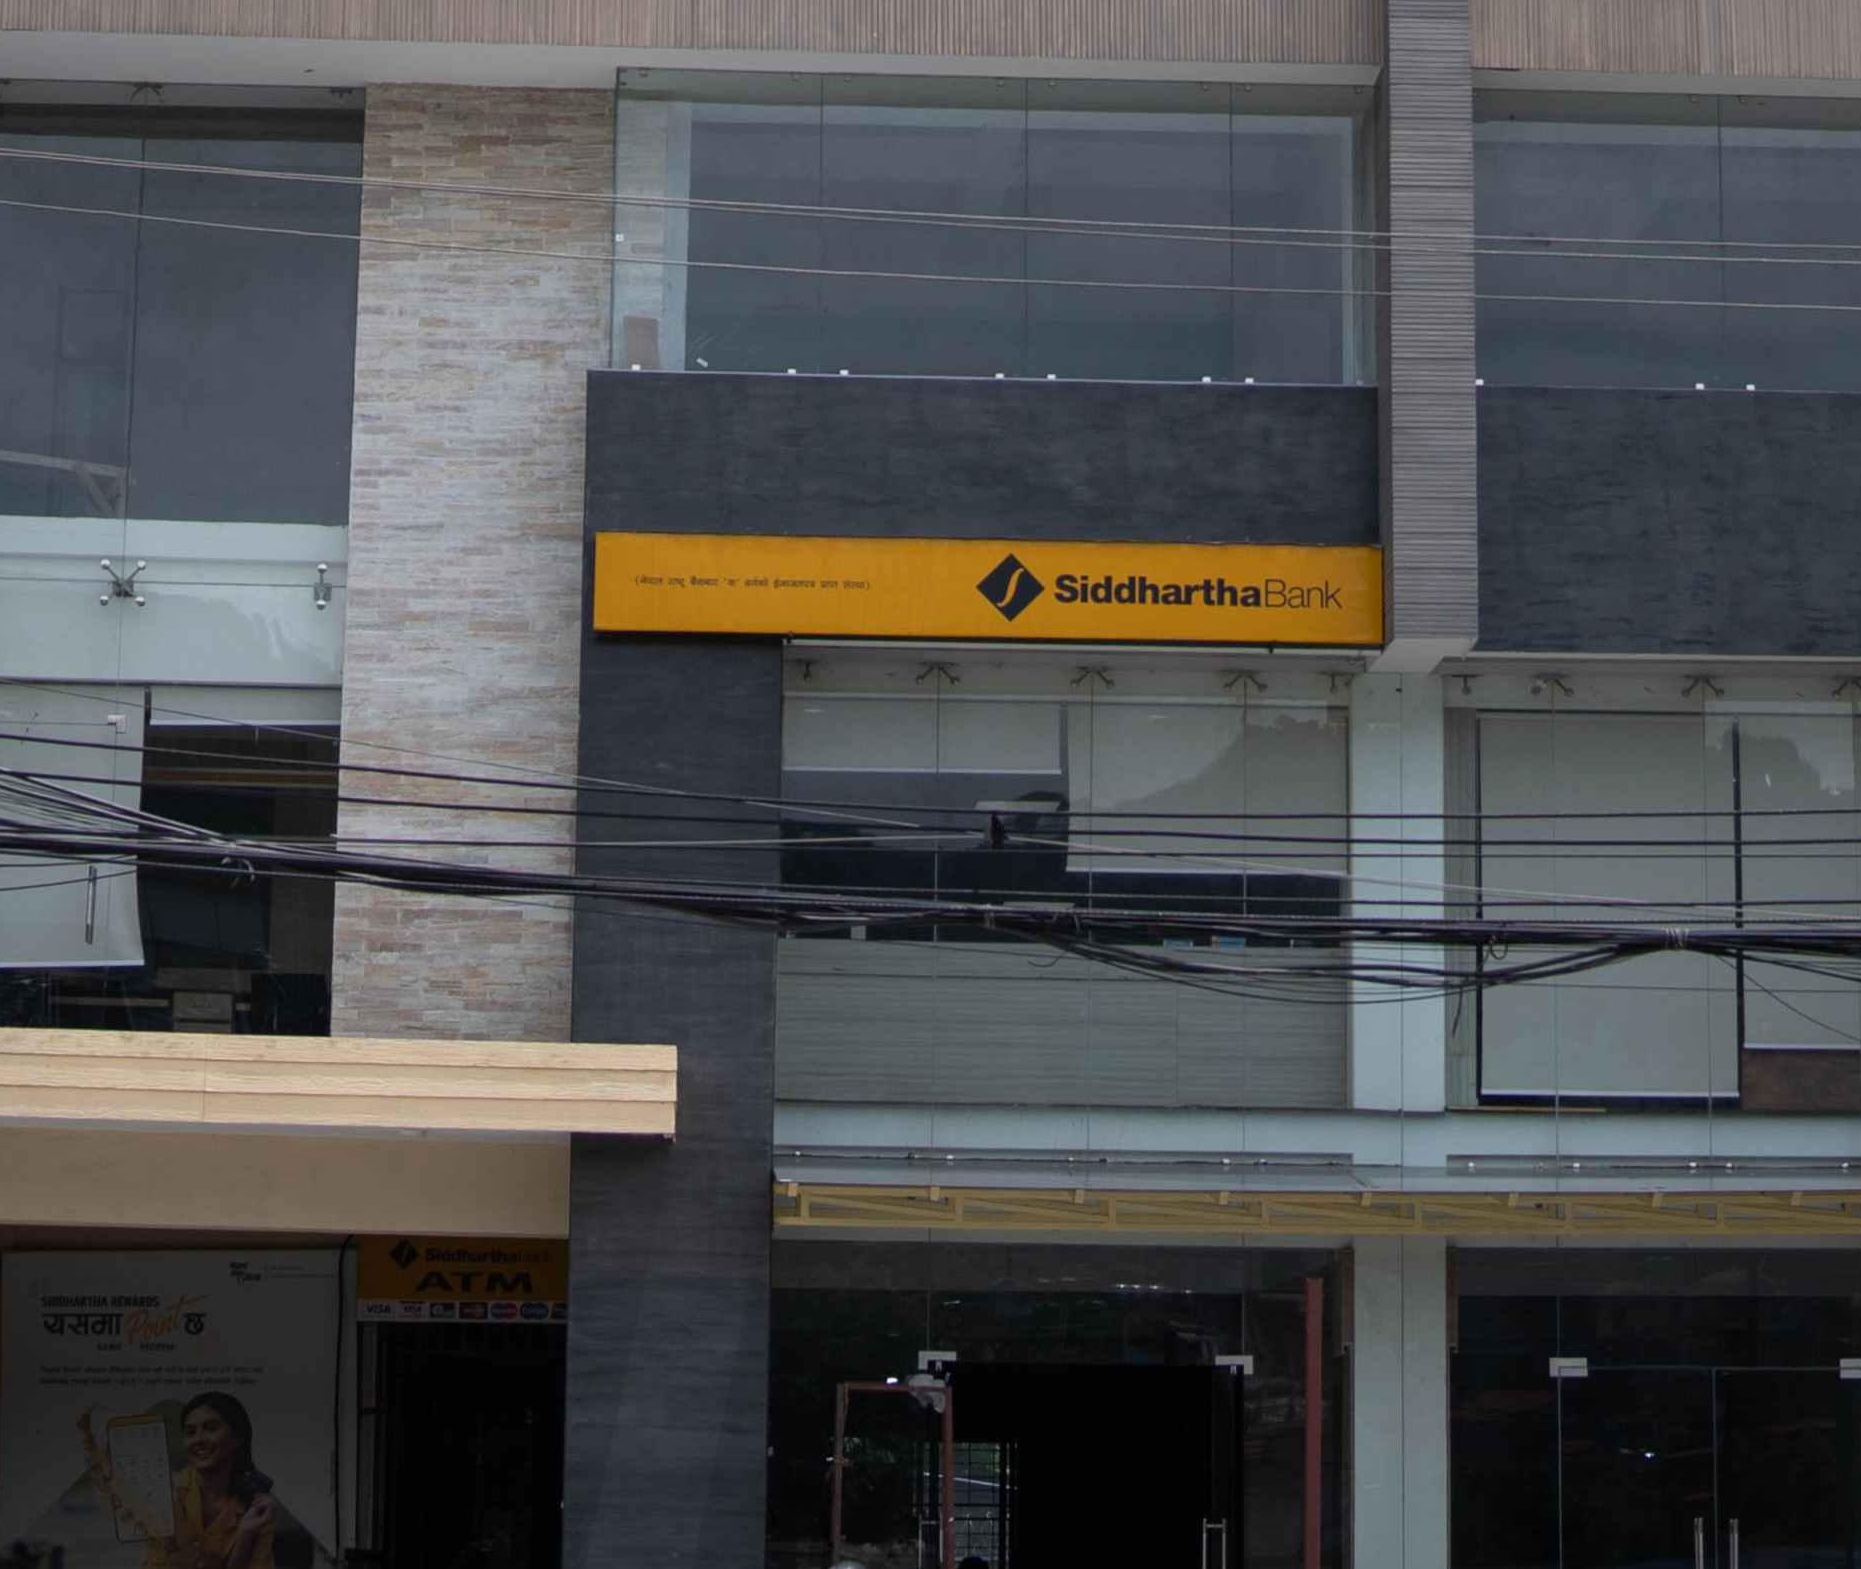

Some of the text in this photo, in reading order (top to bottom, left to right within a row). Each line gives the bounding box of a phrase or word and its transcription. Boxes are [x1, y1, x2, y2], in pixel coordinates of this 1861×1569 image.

[416, 1271, 533, 1293] ATM
[41, 1295, 160, 1307] SIDDHARTHA REWARDS
[366, 1303, 392, 1314] VISA
[42, 1293, 213, 1346] यसमा Point छ
